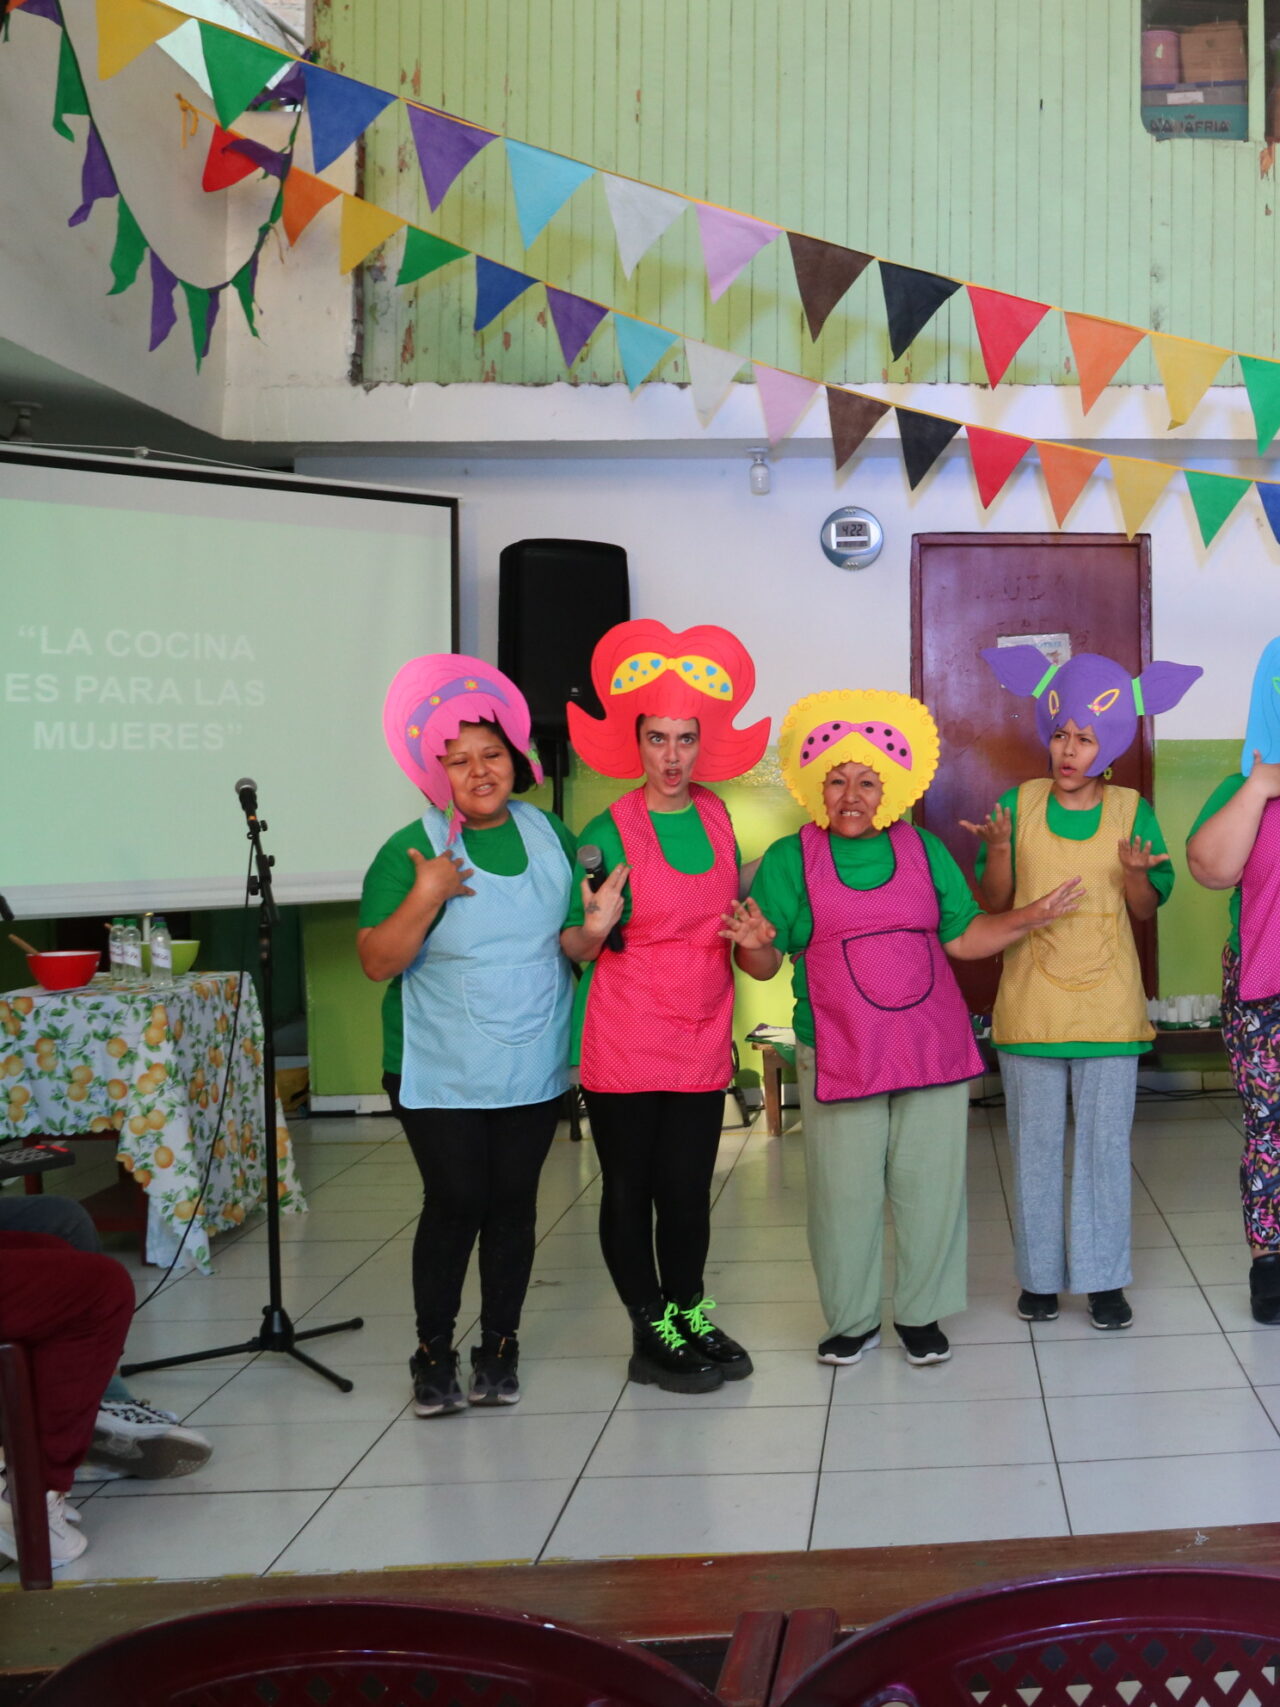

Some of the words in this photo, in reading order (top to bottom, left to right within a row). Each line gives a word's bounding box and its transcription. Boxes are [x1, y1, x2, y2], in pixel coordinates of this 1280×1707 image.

[18, 626, 94, 656] “LA
[105, 629, 256, 661] COCINA
[4, 674, 59, 703] ES
[75, 676, 182, 705] PARA
[194, 678, 266, 707] LAS
[33, 721, 243, 751] MUJERES”
